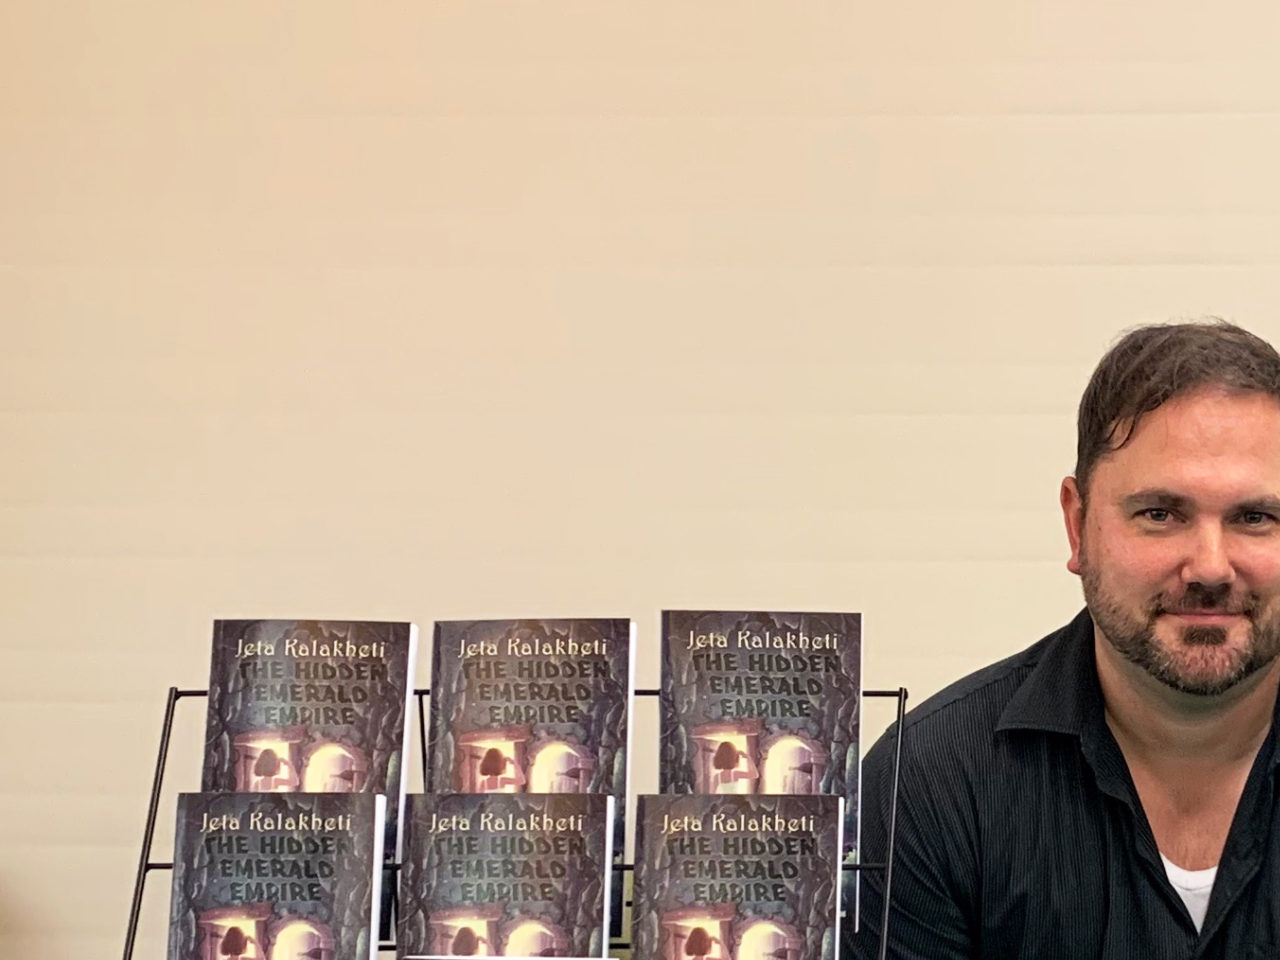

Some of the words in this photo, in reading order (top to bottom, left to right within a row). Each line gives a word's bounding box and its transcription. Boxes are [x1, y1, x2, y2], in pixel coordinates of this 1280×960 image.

[235, 639, 274, 657] Jeta
[285, 639, 386, 659] Kalakheti
[458, 640, 497, 657] Jeta
[508, 639, 607, 657] Kalakheti
[687, 631, 728, 650] Jeta
[738, 631, 838, 650] Kalakheti
[239, 662, 284, 680] THE
[295, 662, 386, 681] HIDDEN
[462, 661, 506, 678] THE
[518, 660, 610, 678] HIDDEN
[692, 653, 738, 673] THE
[749, 654, 841, 673] HIDDEN
[255, 683, 368, 703] EMERALD
[478, 682, 591, 700] EMERALD
[710, 676, 823, 696] EMERALD
[264, 706, 355, 725] EMPIRE
[489, 705, 579, 724] EMPIRE
[722, 698, 811, 718] EMPIRE
[200, 813, 240, 832] Jeta
[250, 812, 350, 832] Kalakheti
[429, 814, 470, 833] Jeta
[480, 813, 583, 833] Kalakheti
[661, 814, 702, 833] Jeta
[712, 814, 814, 833] Kalakheti
[204, 836, 249, 854] THE
[260, 836, 350, 855] HIDDEN
[434, 837, 479, 855] THE
[491, 836, 585, 855] HIDDEN
[666, 837, 711, 856] THE
[723, 837, 817, 856] HIDDEN
[221, 859, 334, 879] EMERALD
[451, 860, 566, 879] EMERALD
[683, 860, 798, 880] EMERALD
[230, 882, 321, 902] EMPIRE
[461, 883, 554, 902] EMPIRE
[693, 883, 786, 902] EMPIRE
